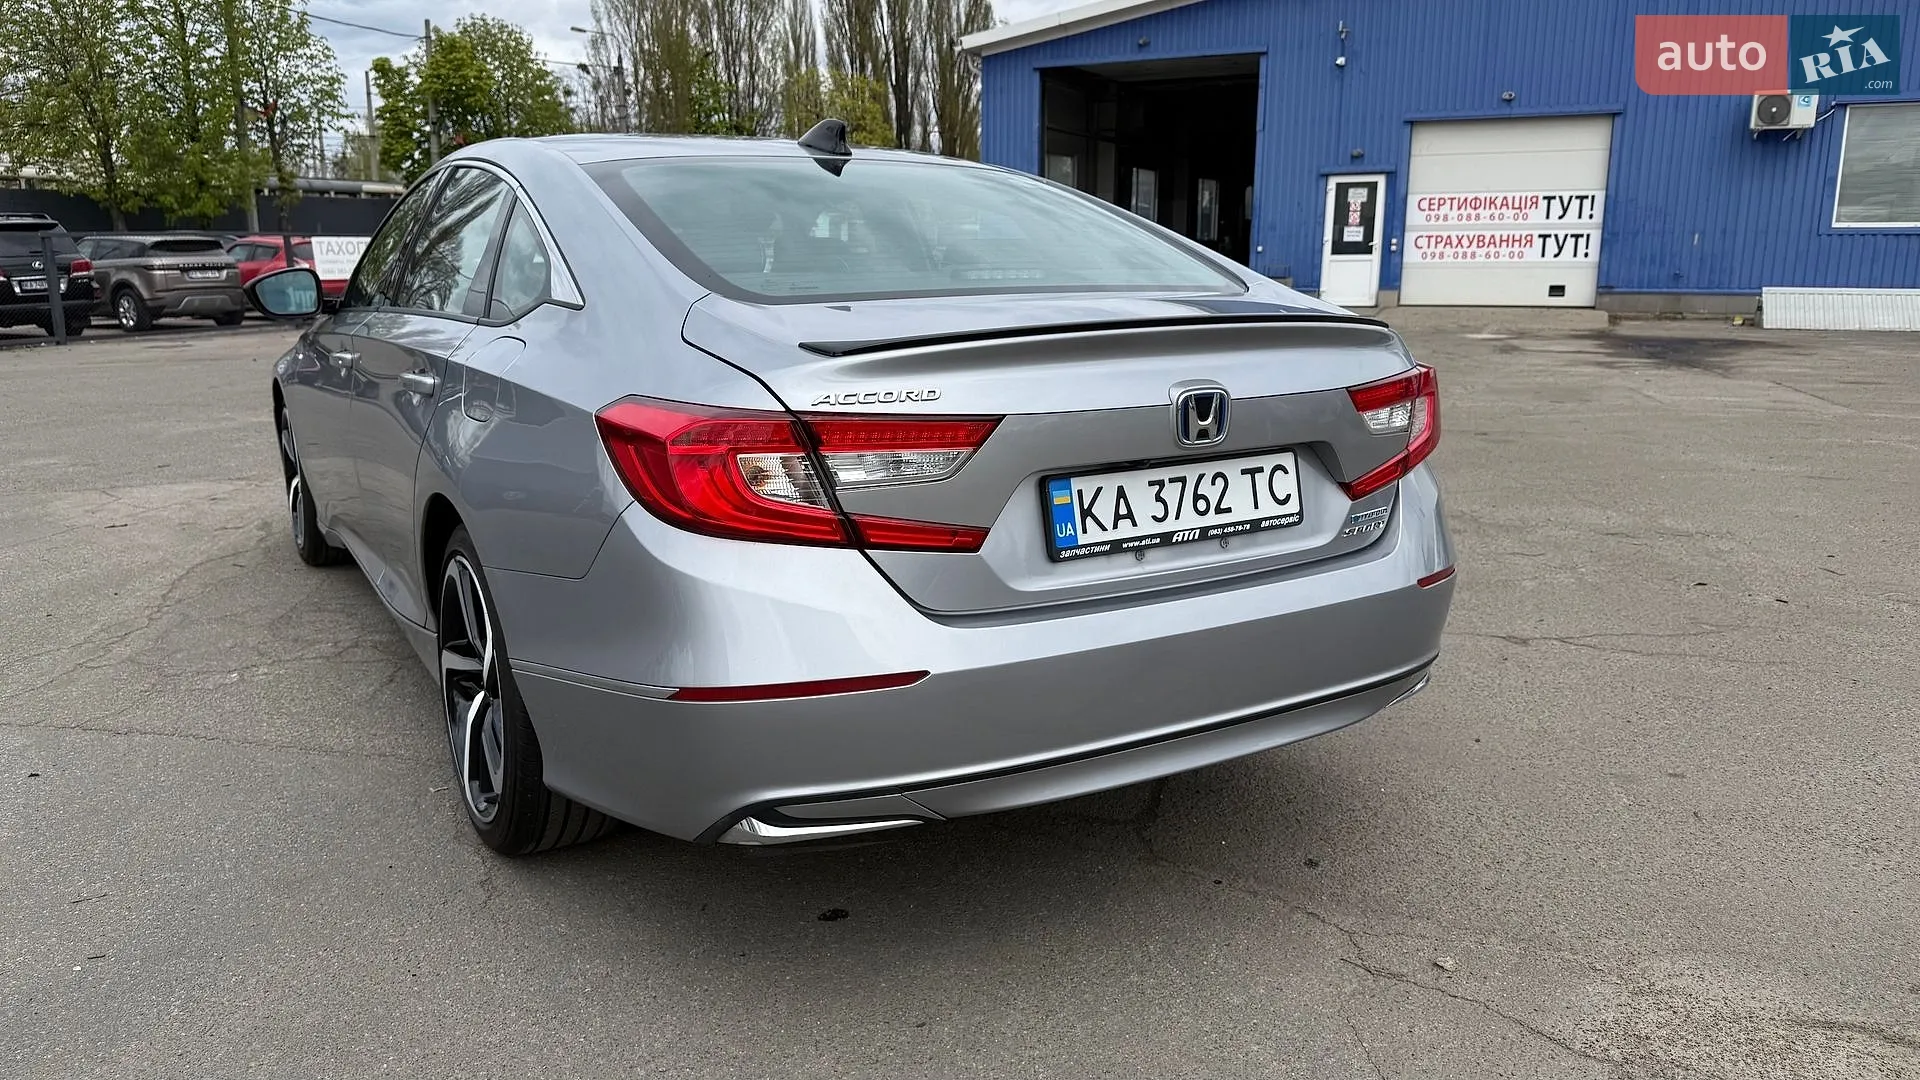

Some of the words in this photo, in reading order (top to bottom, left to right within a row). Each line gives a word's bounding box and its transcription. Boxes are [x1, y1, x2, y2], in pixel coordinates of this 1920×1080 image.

[1417, 195, 1539, 213] СЕРТИФІКАЦІЯ
[1542, 194, 1596, 220] ТУТ!
[1425, 212, 1529, 223] 098-088-60-00
[1414, 234, 1534, 249] СТРАХУВАННЯ
[1538, 233, 1591, 258] ТУТ!
[1421, 250, 1524, 261] 098-088-60-00
[811, 387, 942, 407] ACCORD
[1077, 485, 1138, 535] KA
[1147, 471, 1232, 523] 3762
[1240, 463, 1292, 510] TC
[1056, 521, 1075, 539] UA
[1059, 544, 1111, 559] запчастини
[1260, 515, 1300, 528] автосервіс
